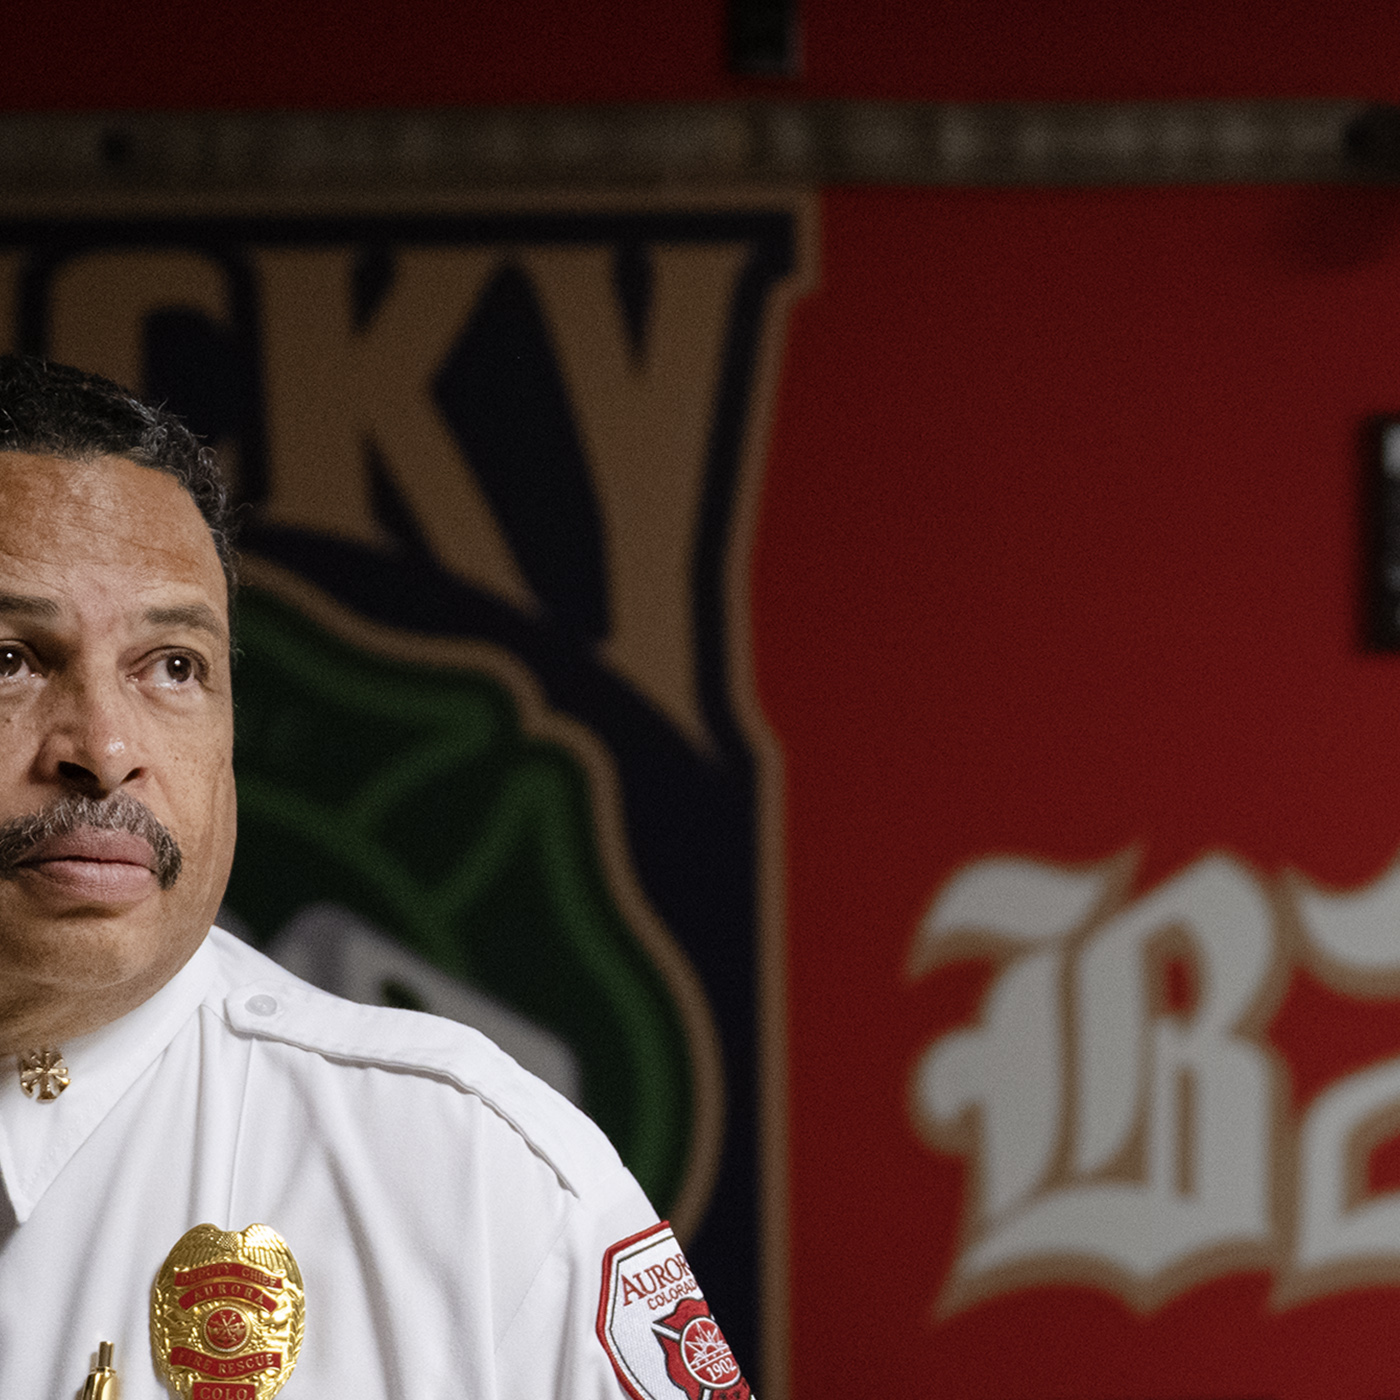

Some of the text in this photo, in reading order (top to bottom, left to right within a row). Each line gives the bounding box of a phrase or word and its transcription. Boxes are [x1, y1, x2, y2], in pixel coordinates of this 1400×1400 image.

[180, 1264, 277, 1287] DEPUTY CHIEF
[194, 1284, 265, 1304] AURORA
[178, 1351, 274, 1374] FIRE RESCUE
[706, 1357, 737, 1381] 1902
